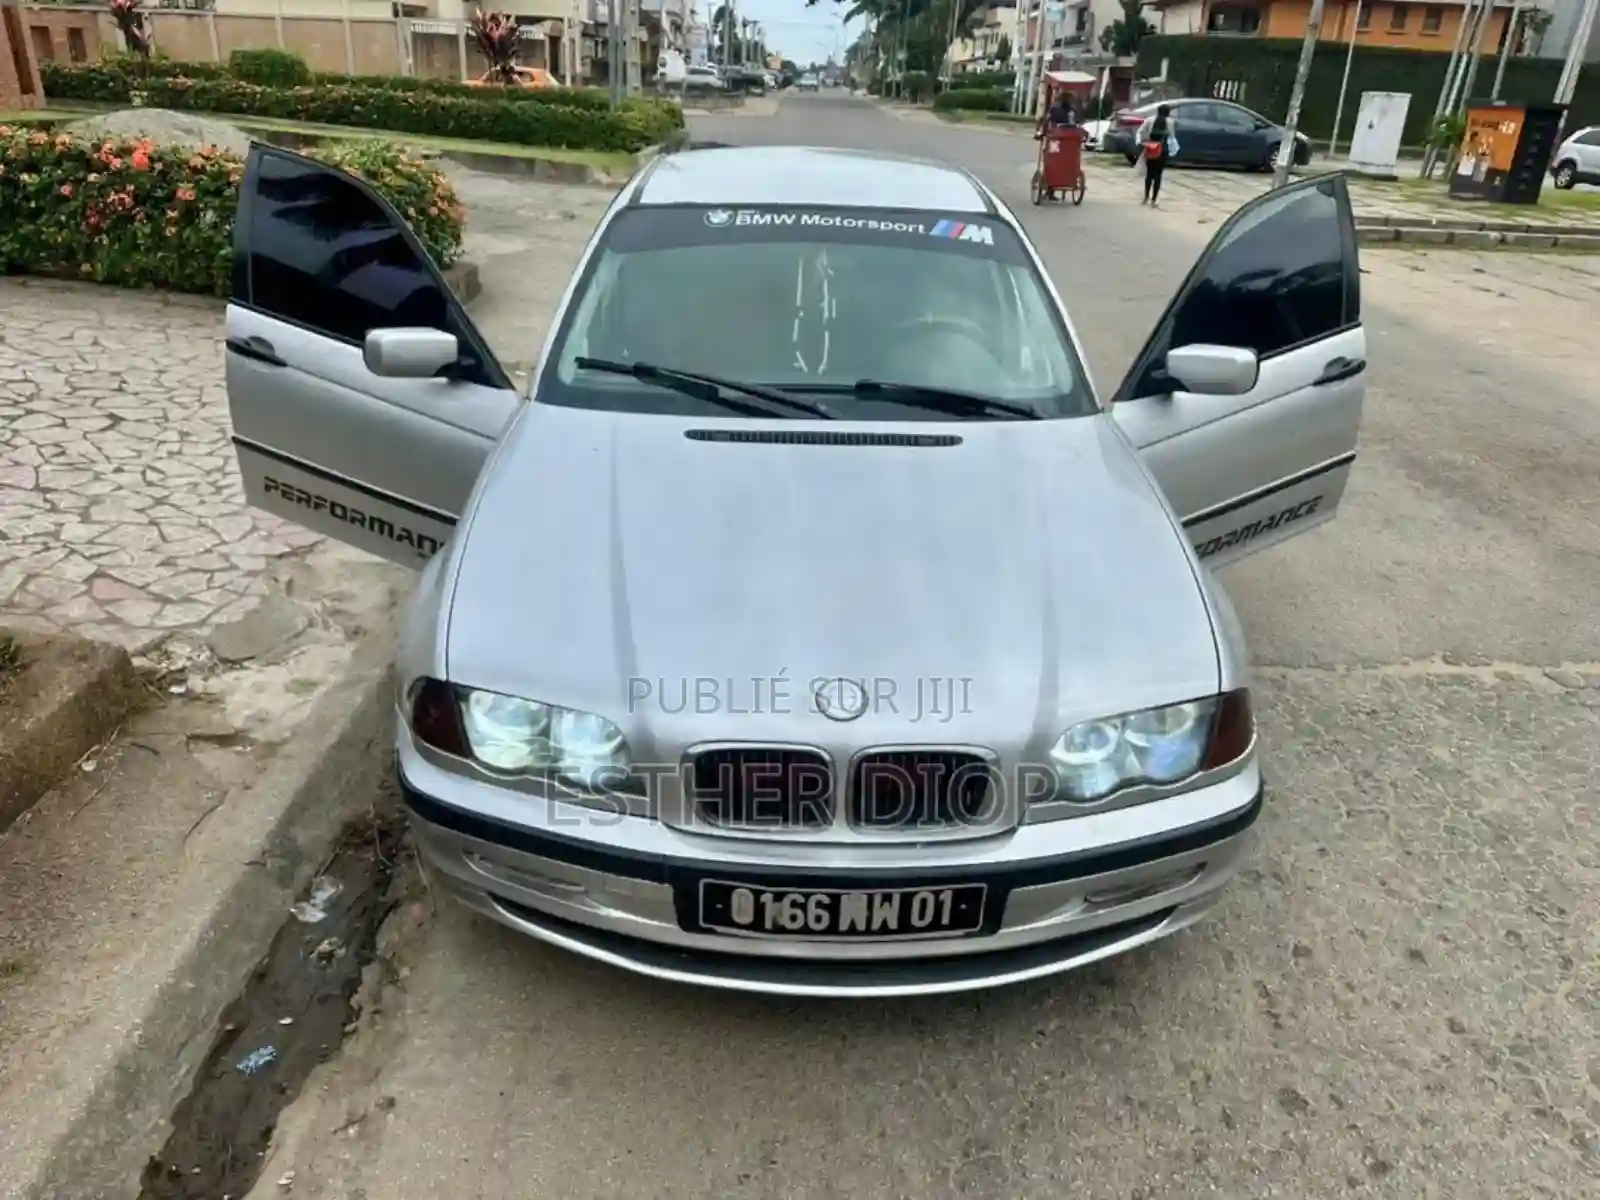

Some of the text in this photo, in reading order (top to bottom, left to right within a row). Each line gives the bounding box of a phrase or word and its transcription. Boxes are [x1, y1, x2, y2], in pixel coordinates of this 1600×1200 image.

[734, 210, 796, 226] BMW
[800, 214, 927, 234] Motorsport
[263, 476, 446, 556] PERFORMAN
[731, 887, 831, 931] 0166
[910, 889, 954, 928] 01
